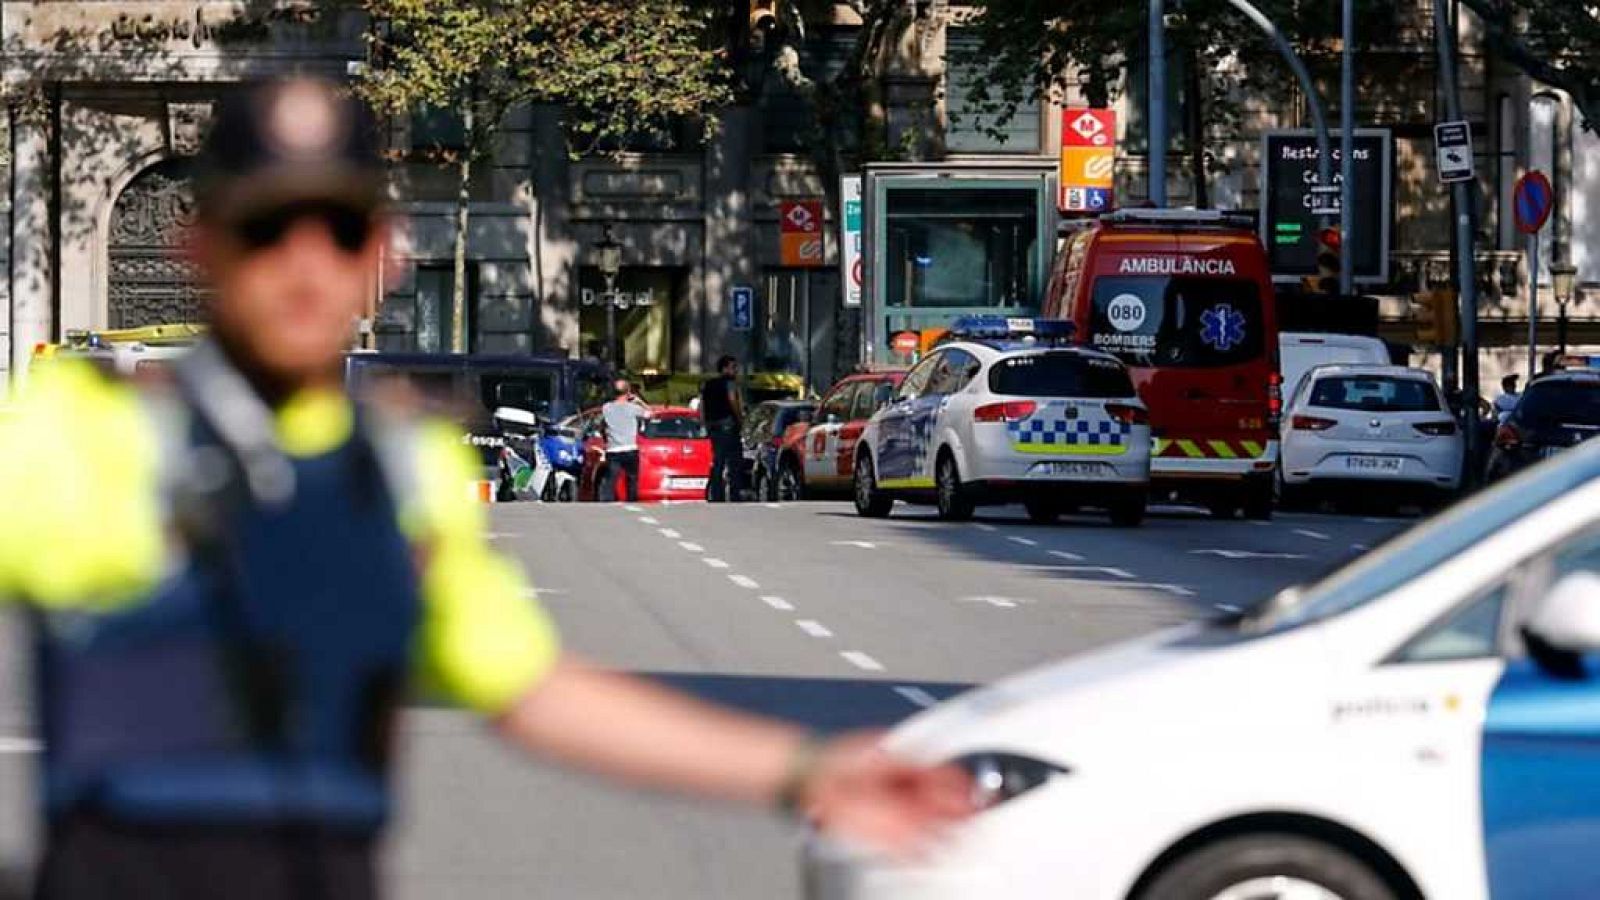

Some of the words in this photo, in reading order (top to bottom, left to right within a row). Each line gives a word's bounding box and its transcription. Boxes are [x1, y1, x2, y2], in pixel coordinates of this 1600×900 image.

[1080, 120, 1095, 131] M
[1119, 256, 1236, 274] AMBULÀNCIA
[1110, 304, 1142, 320] 080
[1093, 333, 1157, 347] BOMBERS
